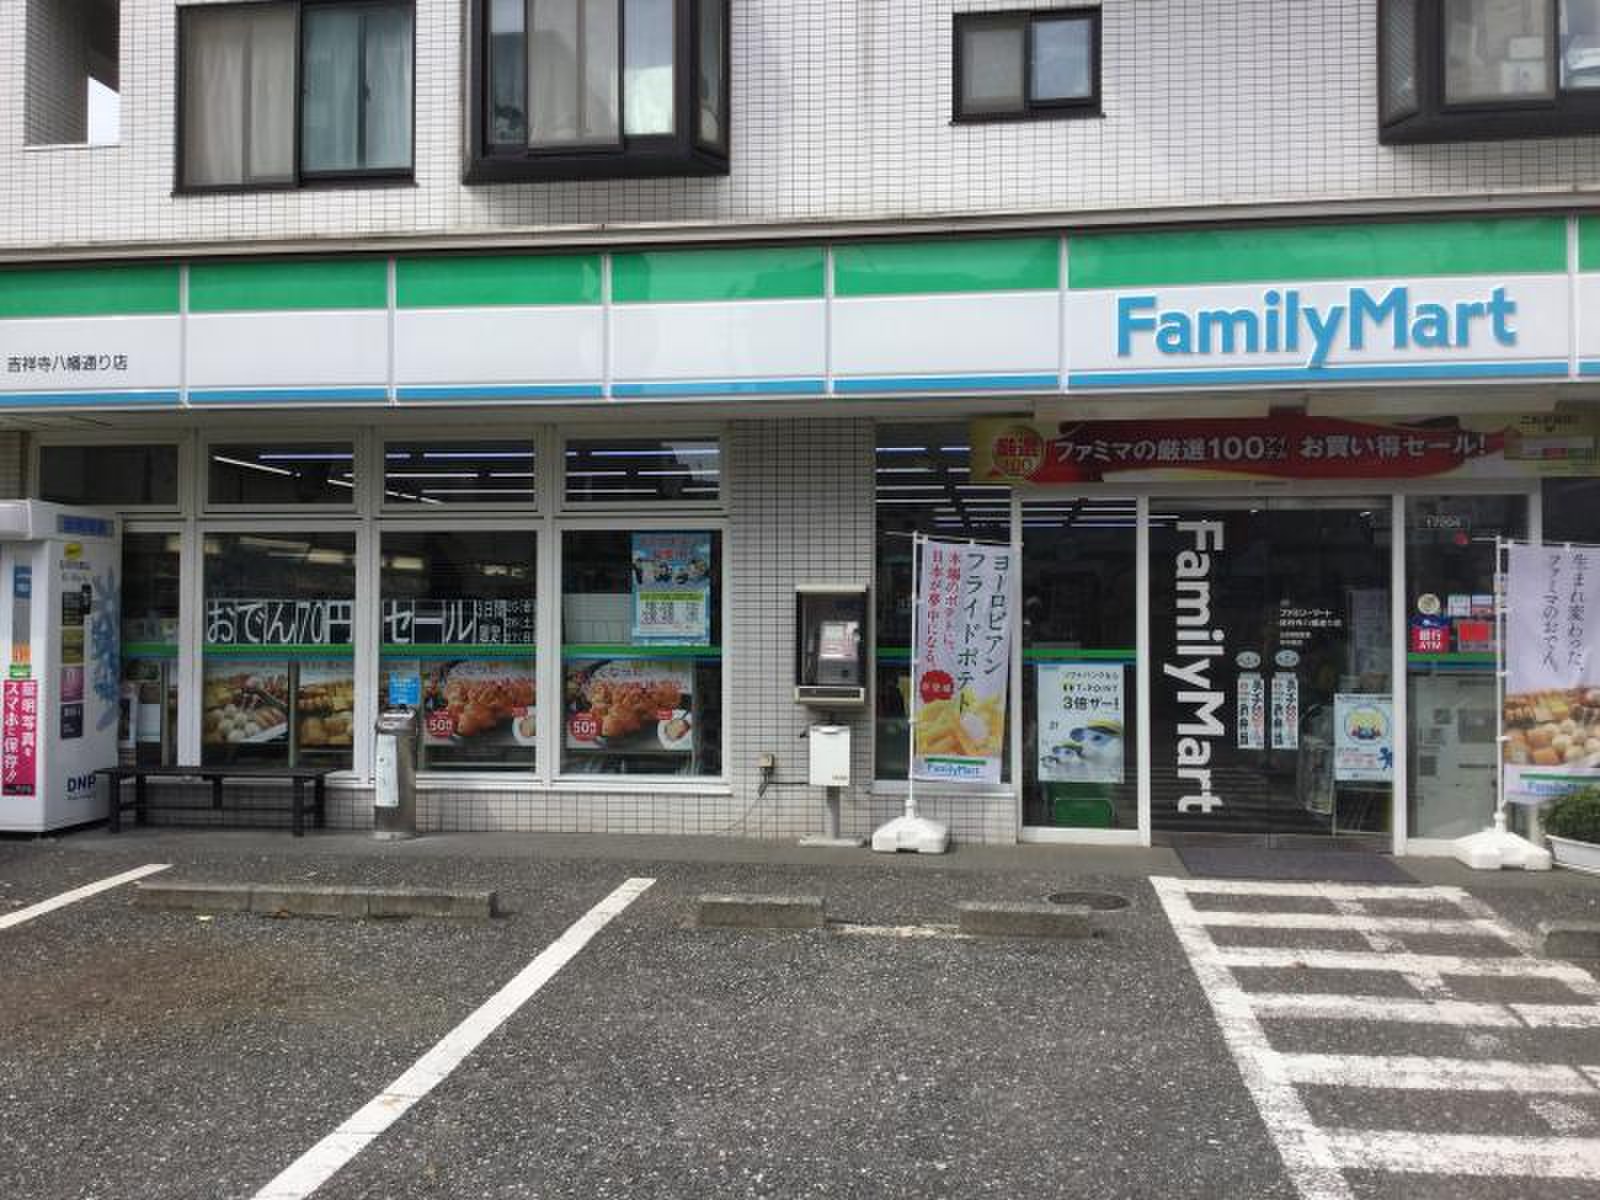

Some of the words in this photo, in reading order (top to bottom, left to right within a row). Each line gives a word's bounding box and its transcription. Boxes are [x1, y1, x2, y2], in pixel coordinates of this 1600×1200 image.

[8, 355, 128, 372] 吉祥寺八幡通り店
[1117, 287, 1517, 368] FamilyMart
[384, 600, 472, 642] セール
[957, 552, 984, 712] フライドポテト
[985, 555, 1008, 674] ヨーロピアン
[1164, 520, 1225, 813] FamilyMart
[67, 775, 96, 793] DNP
